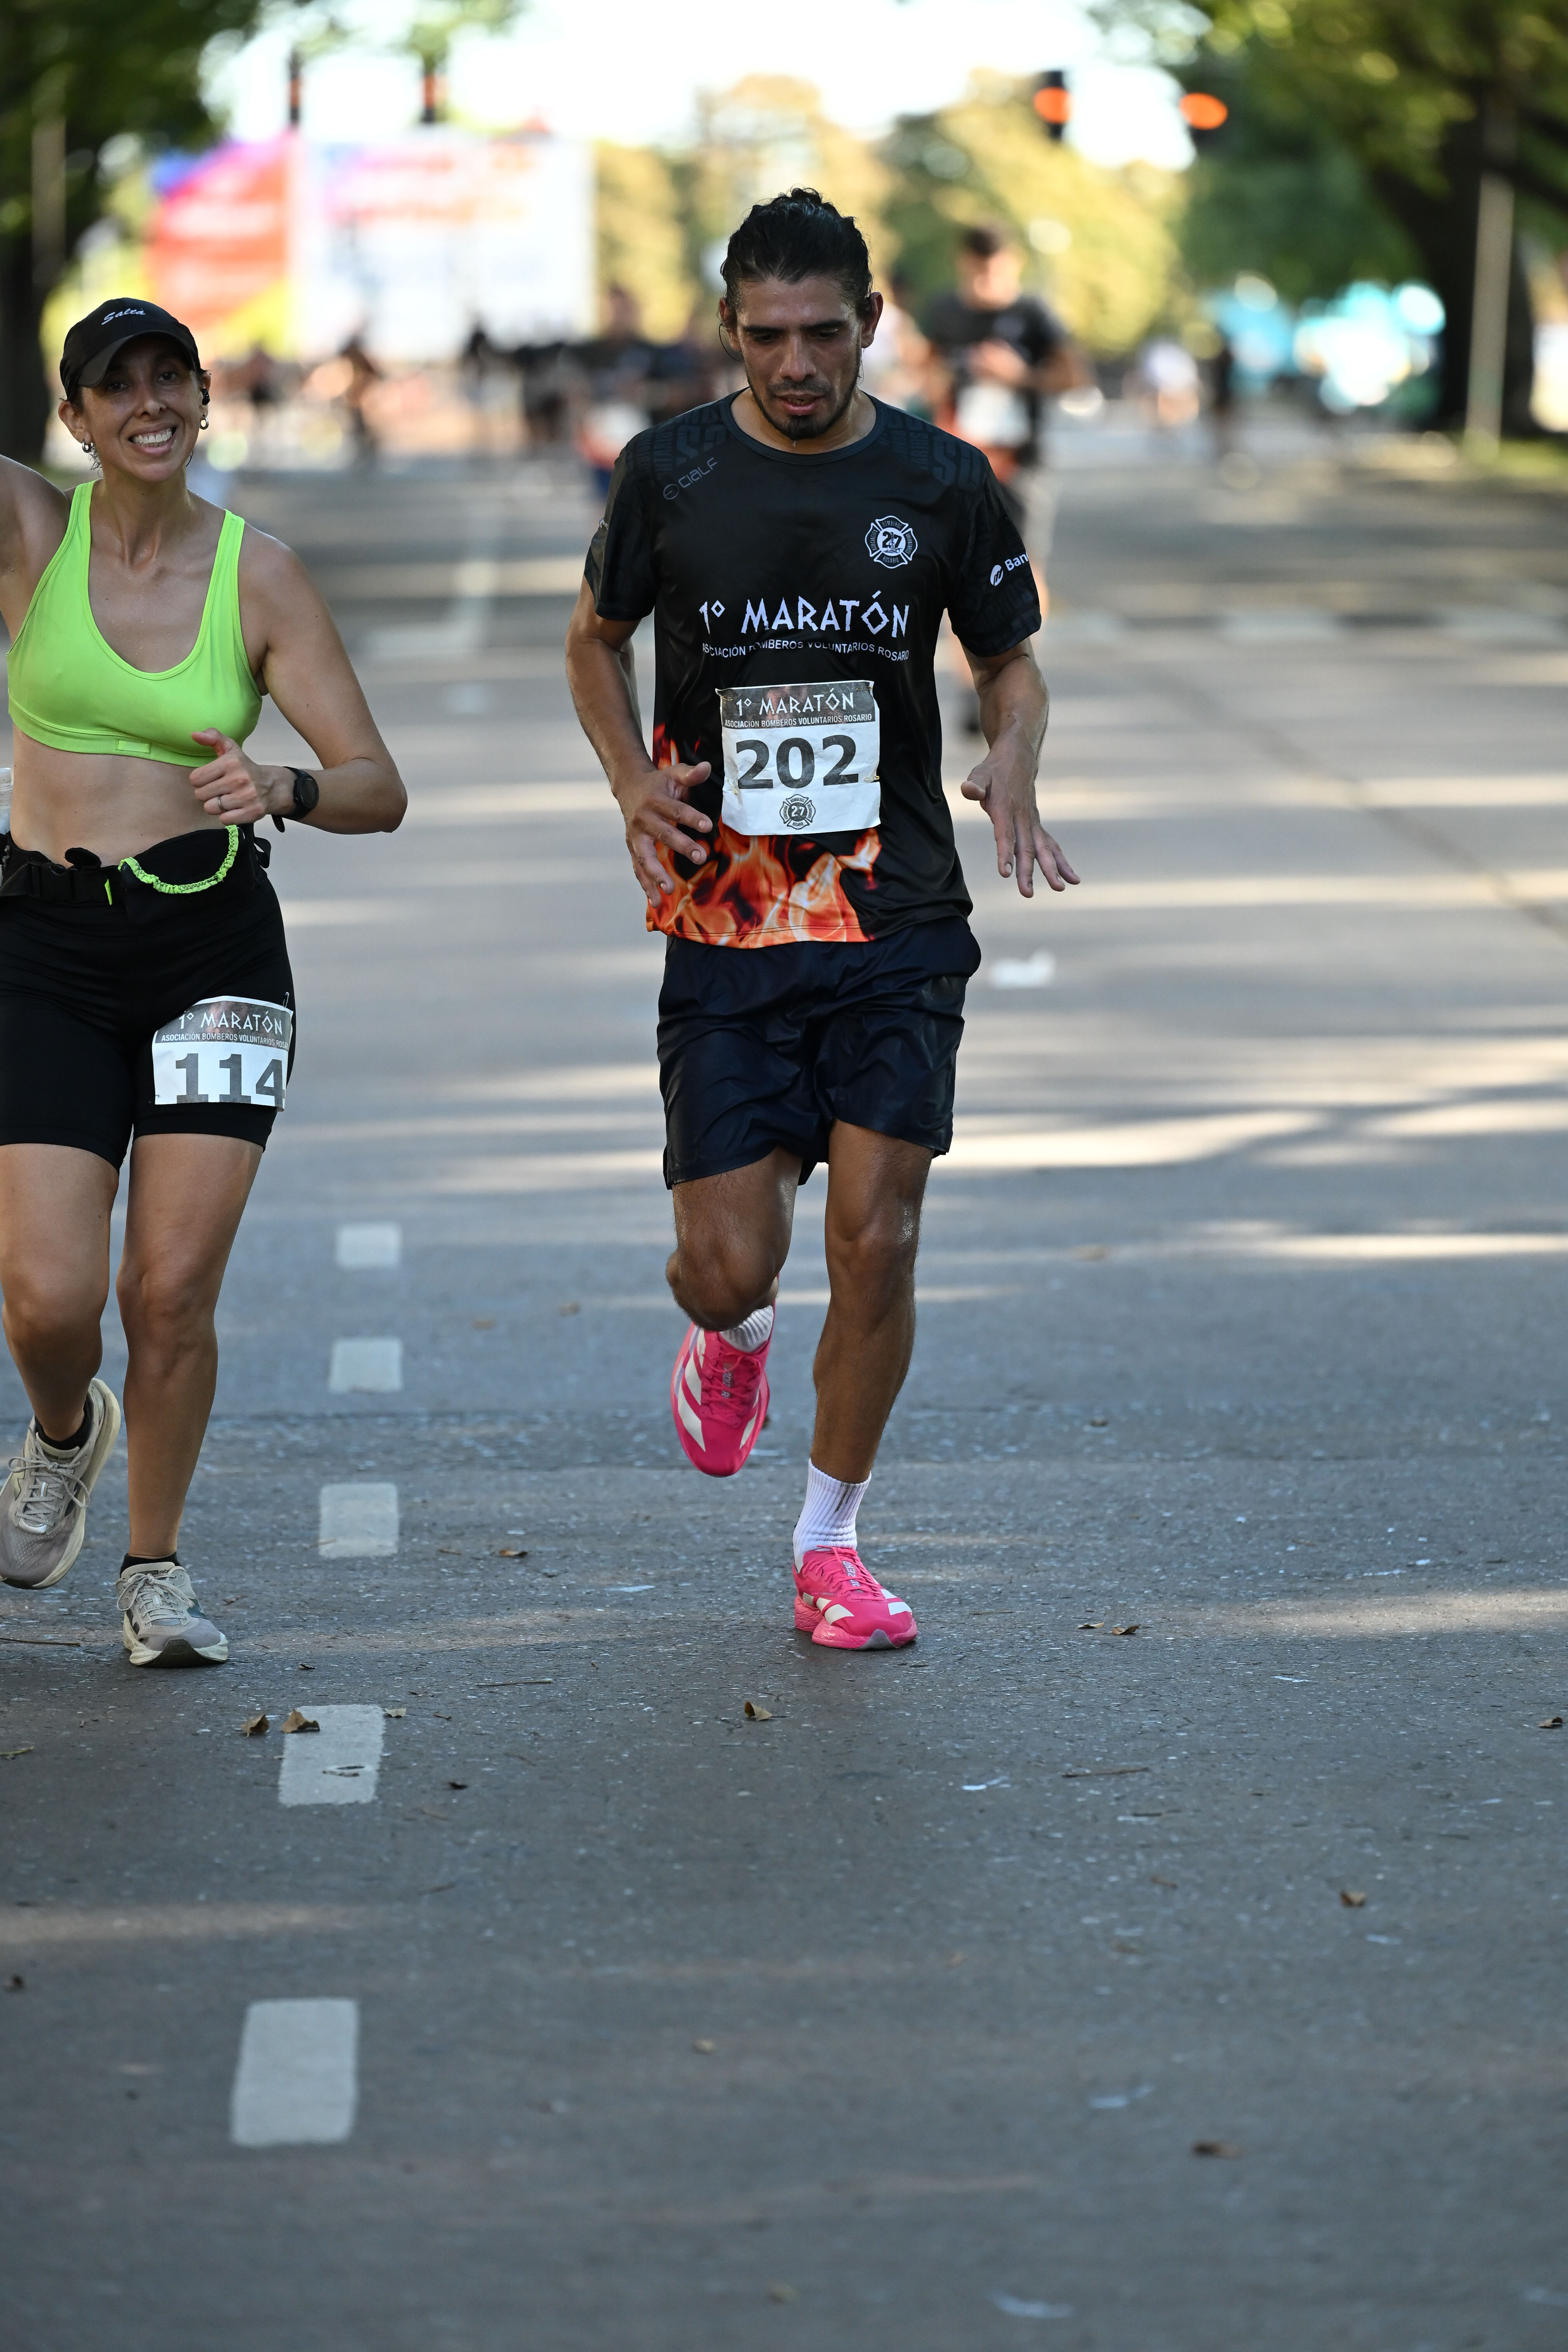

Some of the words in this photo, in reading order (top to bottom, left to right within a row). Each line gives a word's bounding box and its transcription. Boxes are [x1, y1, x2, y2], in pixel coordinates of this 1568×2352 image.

[882, 530, 902, 548] 27
[1004, 551, 1029, 571] Ban
[740, 590, 909, 638] MARATÓN
[702, 642, 746, 658] ASCIACIÓN
[807, 641, 875, 654] VOLUNTARIOS
[878, 646, 909, 662] ROSARIO
[759, 688, 854, 716] MARATÓN
[725, 719, 760, 728] ASOCIACIÓN
[761, 718, 797, 728] BOMBEROS
[798, 715, 842, 725] VOLUNTARIOS
[844, 713, 872, 722] ROSARIO
[736, 735, 859, 789] 202
[791, 805, 805, 817] 27
[200, 1010, 283, 1036] MARATÓN
[161, 1031, 200, 1042] ASOCIACIÓN
[202, 1032, 238, 1041] BOMBEROS
[238, 1034, 275, 1046] VOLUNTARIOS
[175, 1053, 285, 1112] 114
